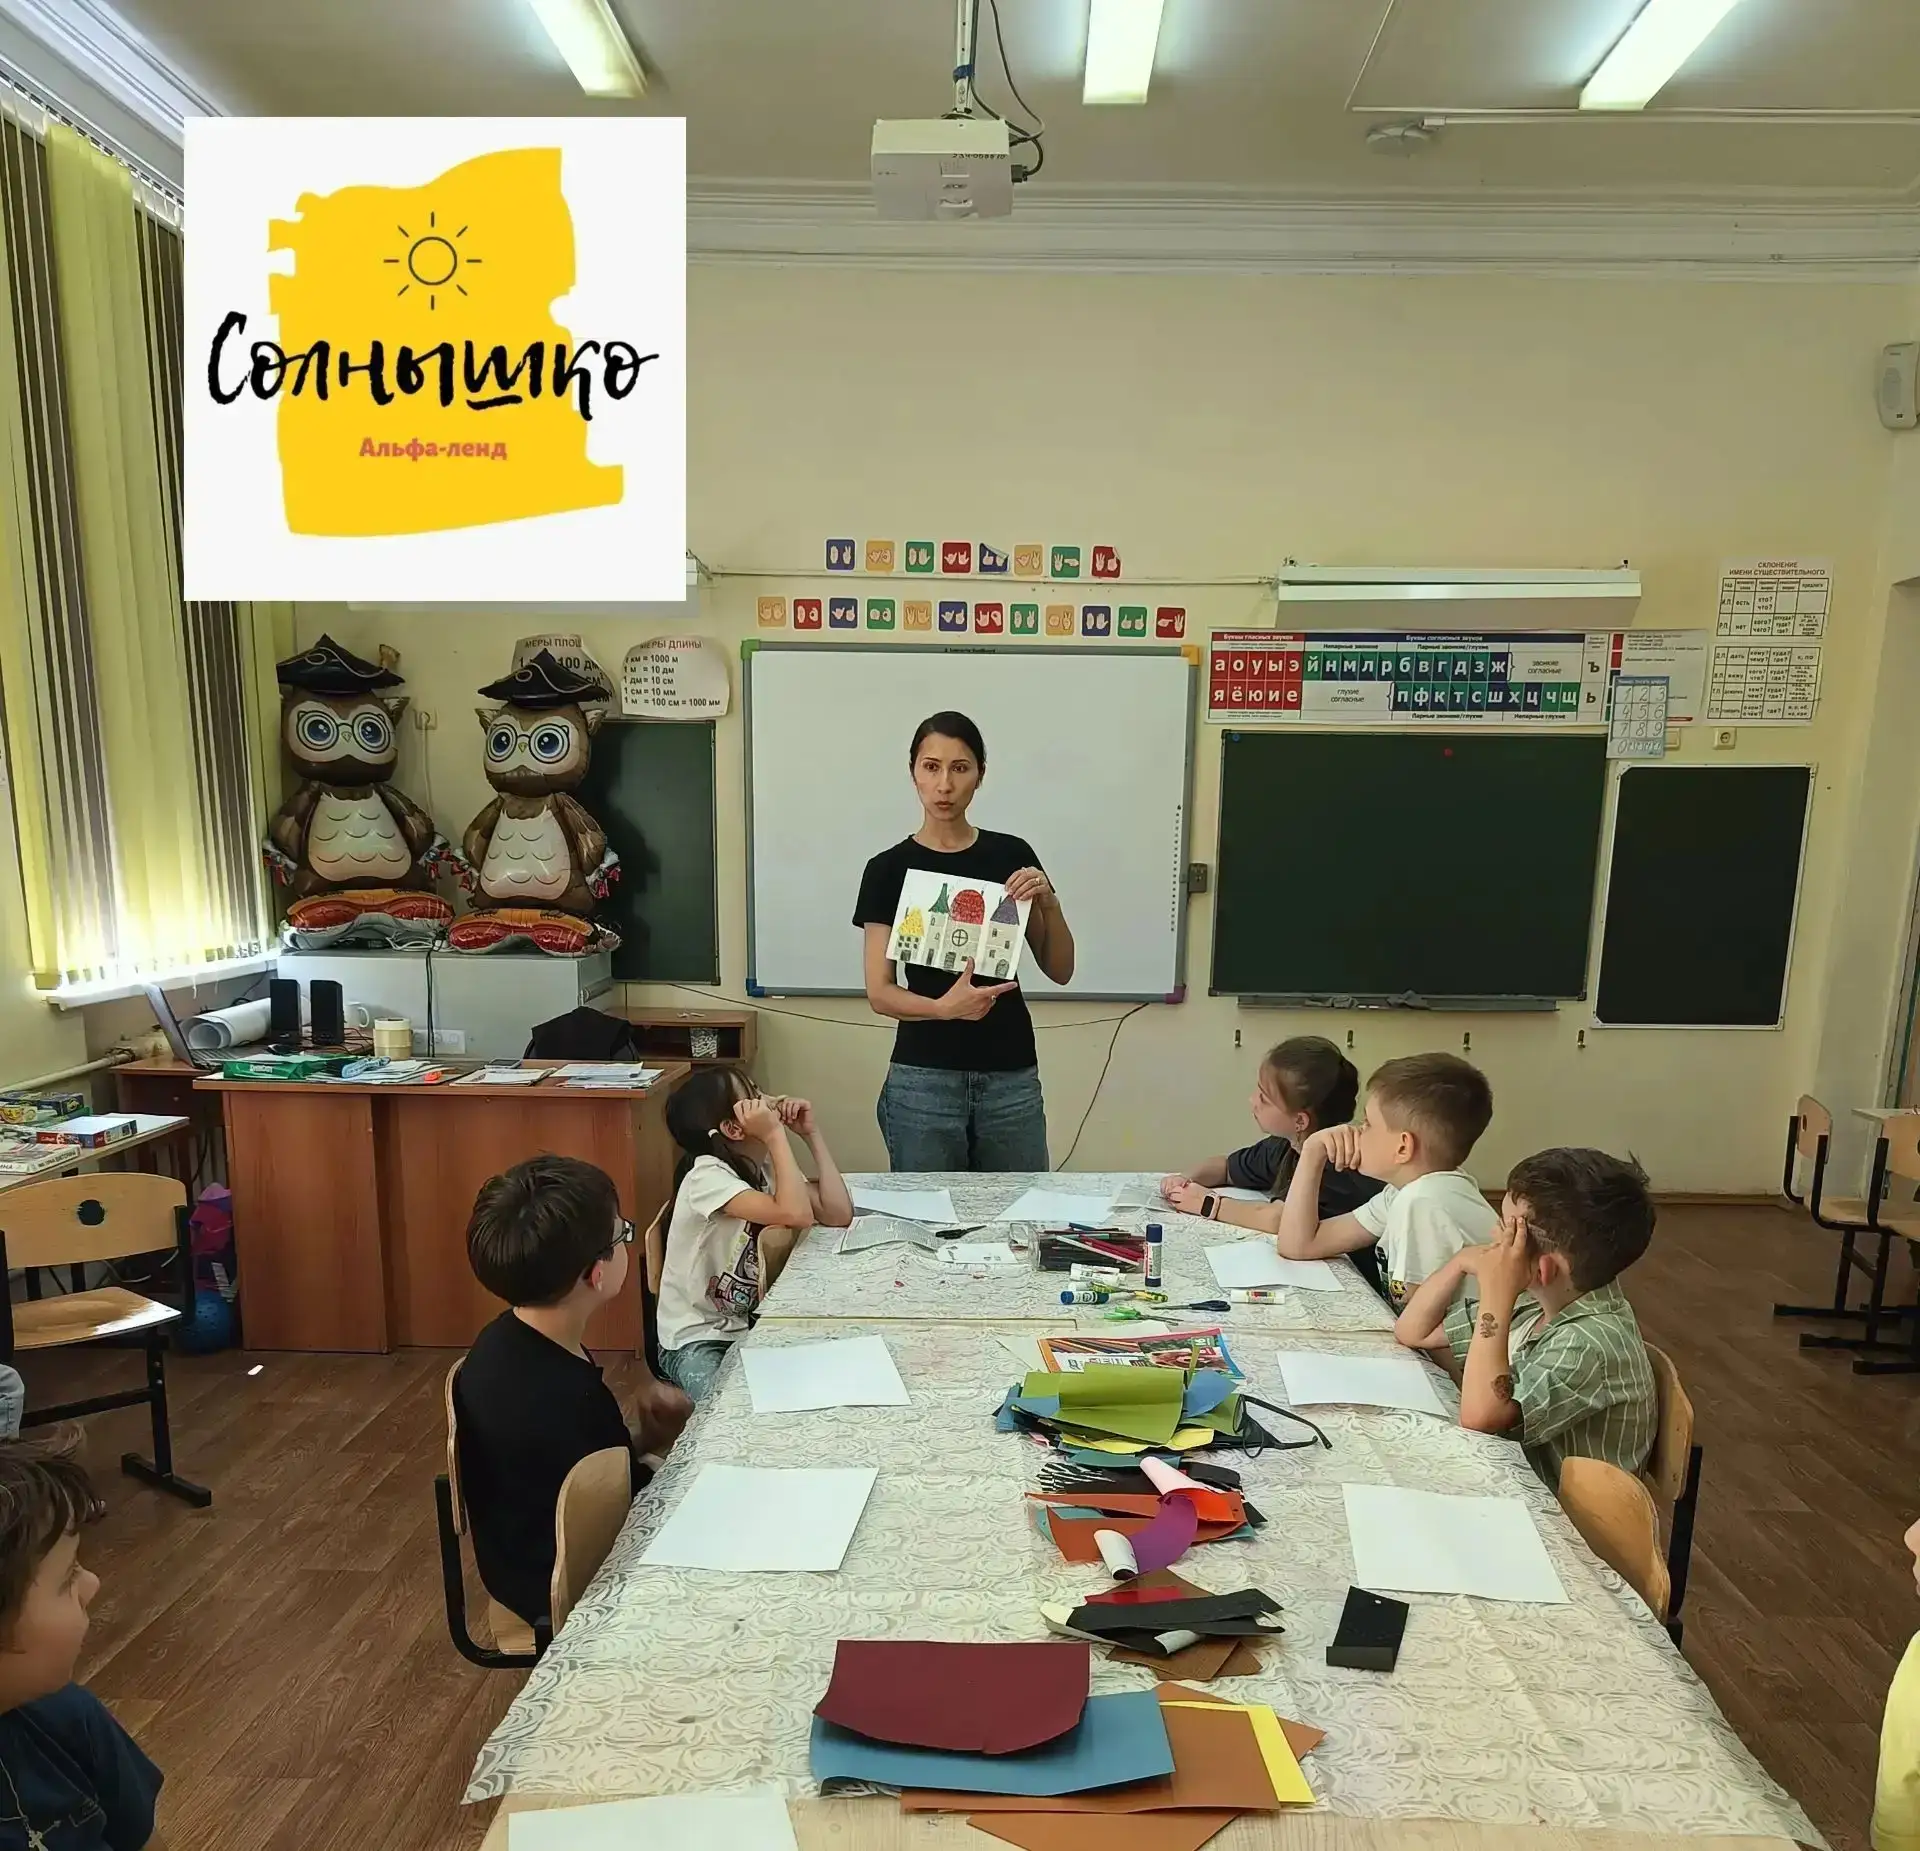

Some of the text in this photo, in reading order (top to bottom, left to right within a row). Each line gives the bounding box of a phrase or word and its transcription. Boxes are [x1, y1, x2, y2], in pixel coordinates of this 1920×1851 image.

[1757, 561, 1798, 569] СКЛОНЕНИЕ
[524, 638, 552, 648] МЕРЫ
[641, 639, 702, 650] МЕРЫ ДЛИНЫ
[650, 654, 670, 663] 1000
[1531, 659, 1559, 667] звонкие
[623, 665, 628, 673] 1
[651, 665, 660, 673] 10
[662, 667, 675, 675] дм
[1527, 667, 1562, 675] согласные
[623, 675, 628, 684] 1
[629, 676, 643, 685] дм
[651, 676, 661, 684] 10
[662, 677, 674, 685] см
[624, 687, 628, 695] 1
[651, 687, 661, 696] 10
[1336, 688, 1360, 697] глухие
[1639, 687, 1648, 701] 2
[1656, 687, 1665, 701] 3
[624, 696, 628, 704] 1
[652, 698, 666, 706] 100
[668, 699, 680, 707] см
[689, 698, 706, 706] 1000
[1330, 695, 1365, 703] согласные
[1622, 704, 1664, 719] 4 5 6
[1620, 722, 1662, 736] 7 8 9
